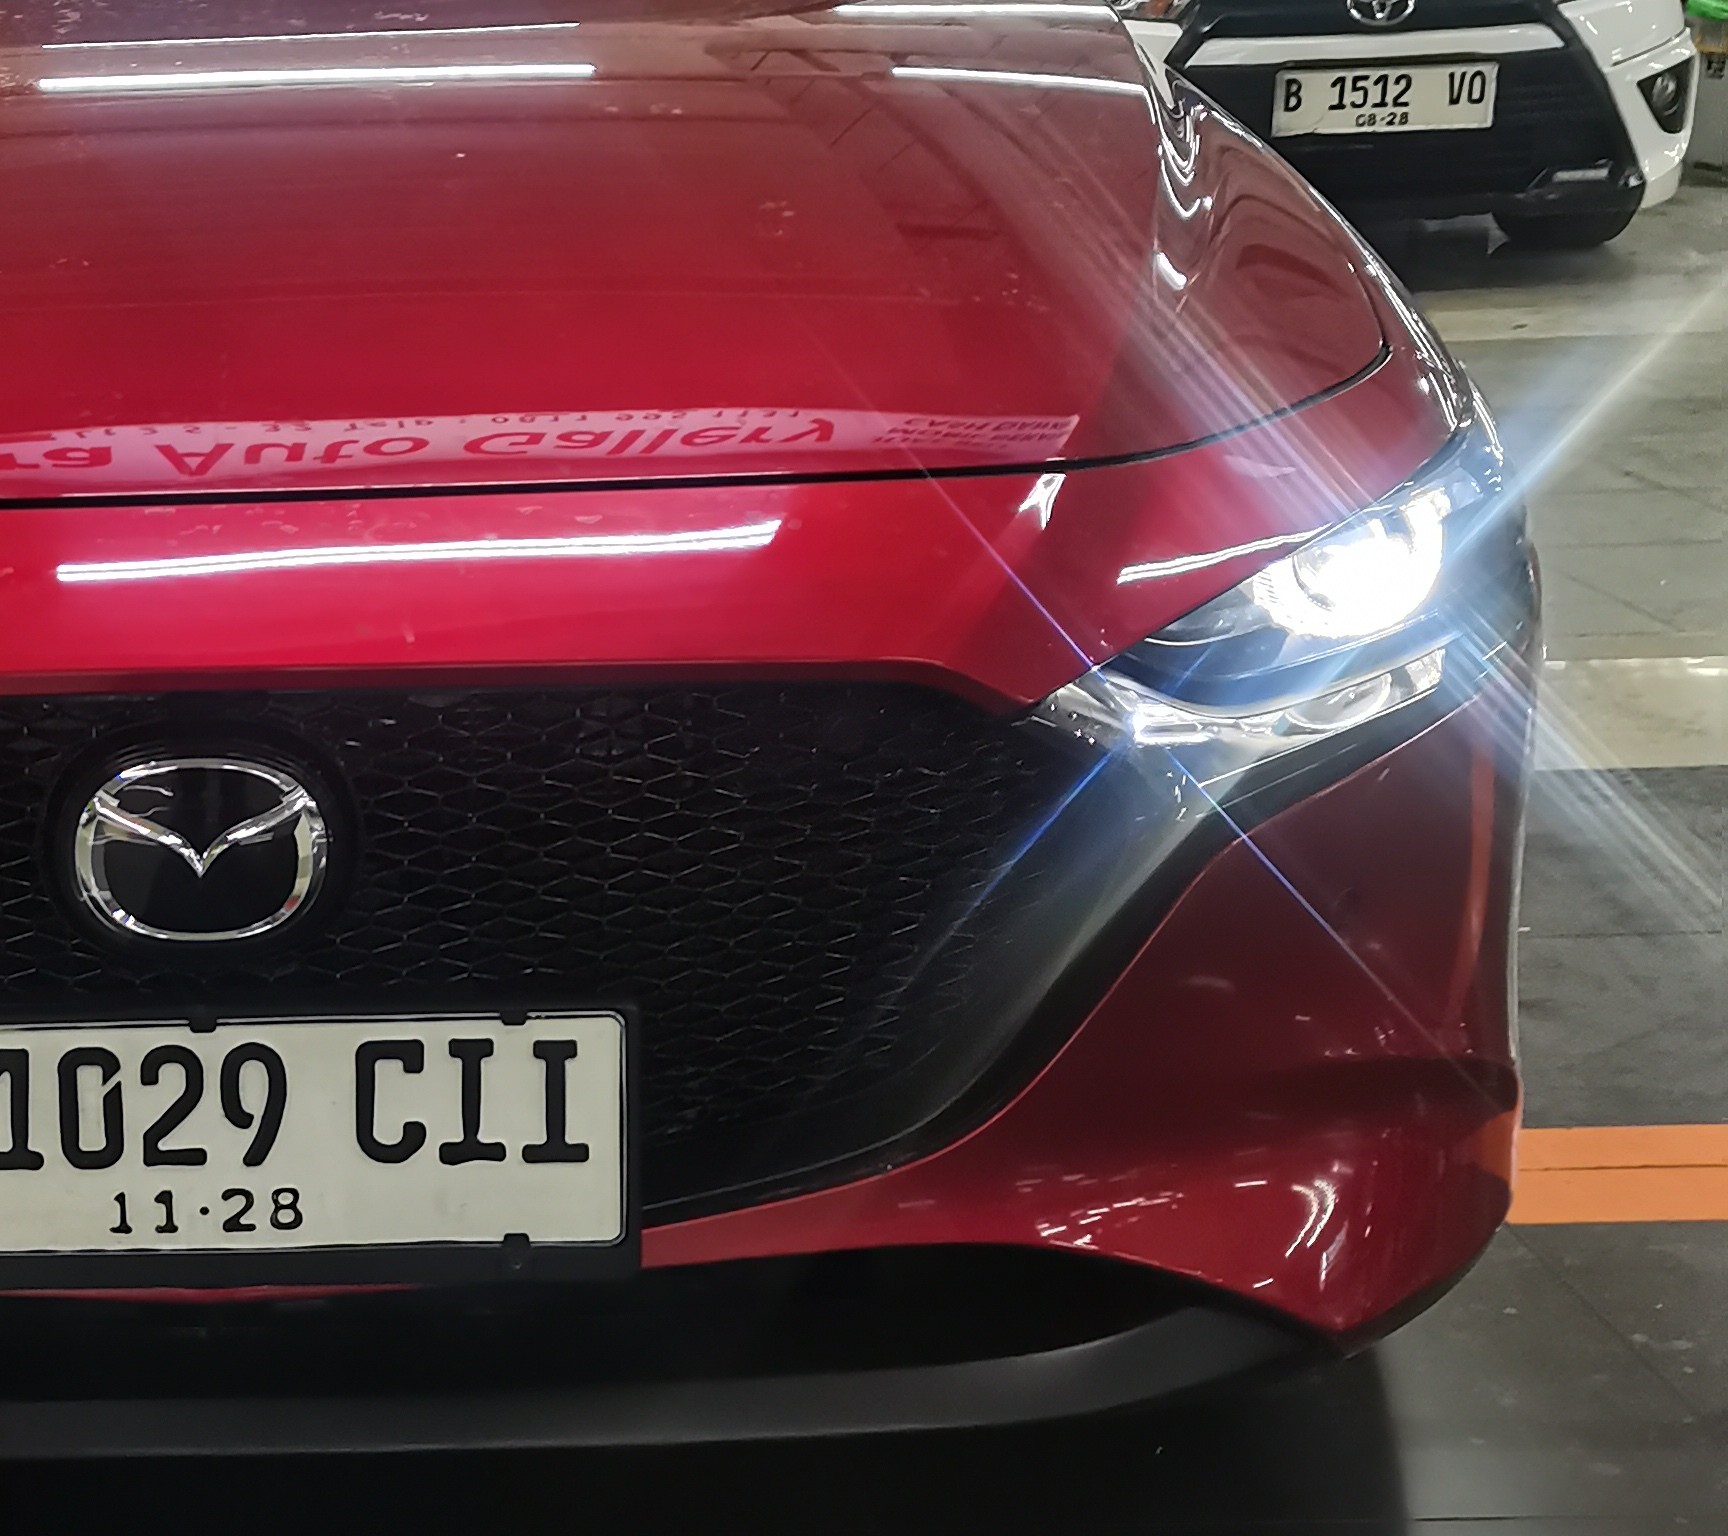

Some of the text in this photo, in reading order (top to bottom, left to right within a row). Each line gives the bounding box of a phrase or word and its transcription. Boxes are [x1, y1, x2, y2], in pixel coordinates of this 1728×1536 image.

[1283, 70, 1487, 112] B 1512 VO
[354, 1036, 591, 1165] CII
